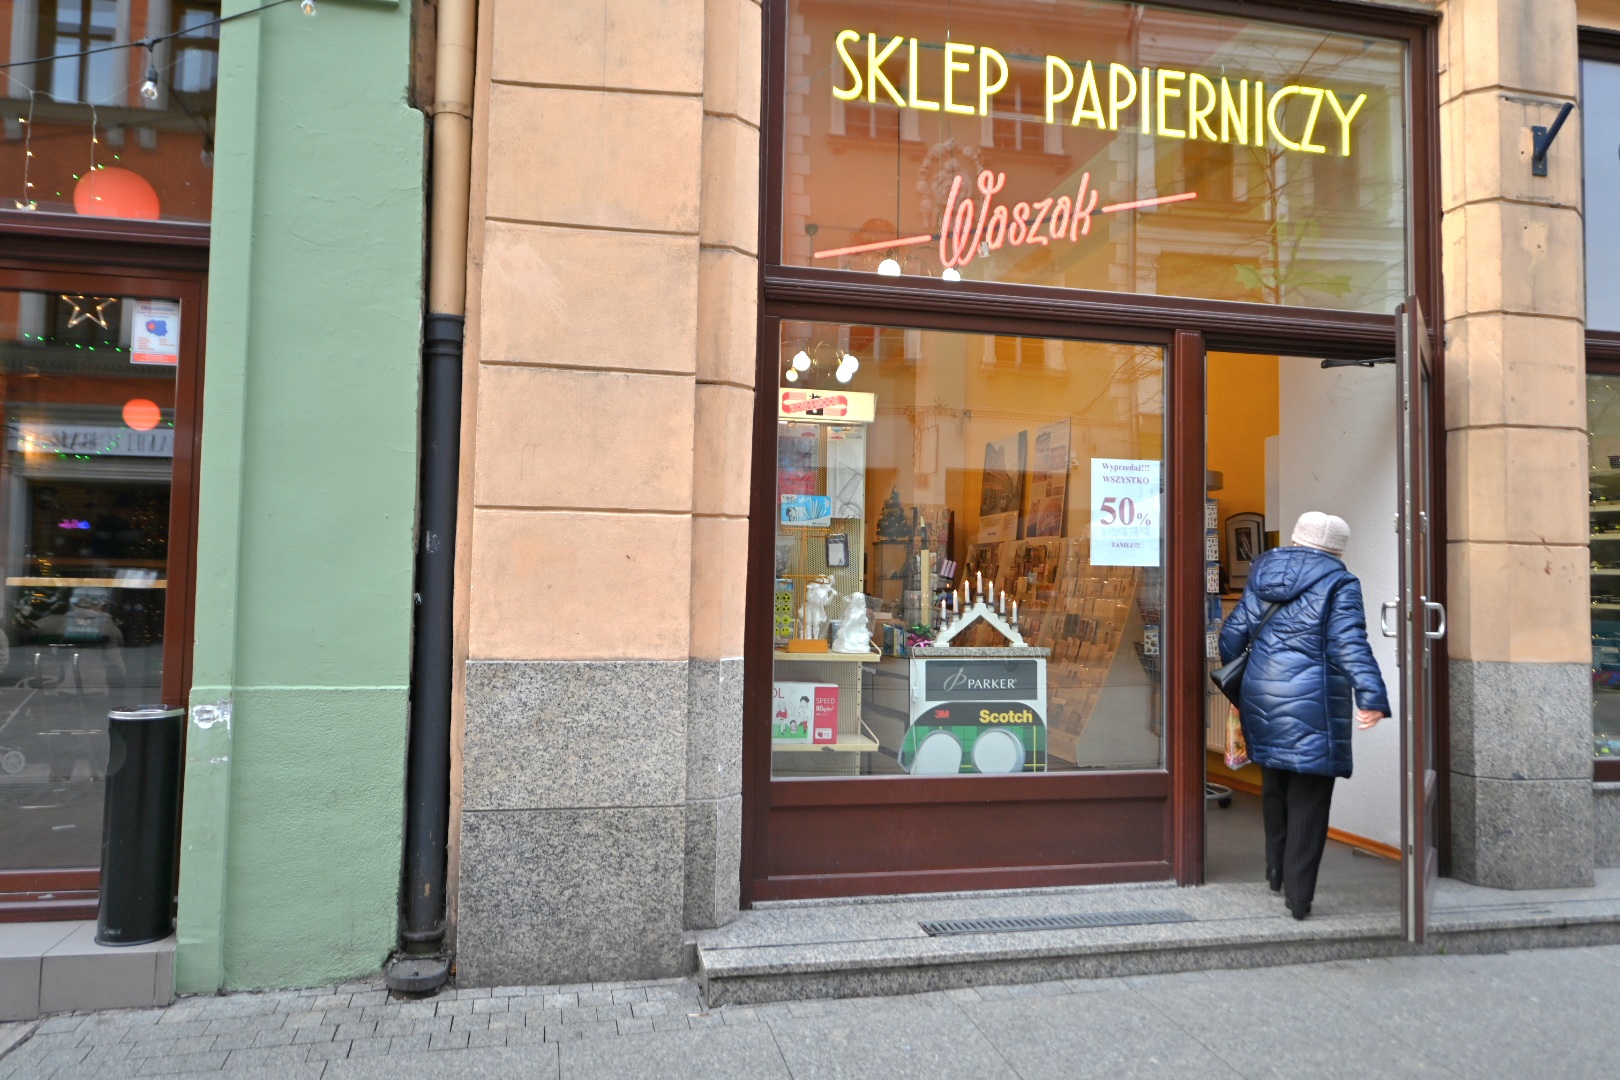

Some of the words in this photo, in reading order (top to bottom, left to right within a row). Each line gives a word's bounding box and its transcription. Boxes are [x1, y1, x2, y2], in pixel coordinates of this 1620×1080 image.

[832, 29, 1009, 116] SKLEP
[1045, 55, 1367, 156] PAPIERNICZY
[938, 169, 1099, 268] Waszak
[1102, 462, 1150, 472] Wyprzedaż!!!
[1102, 475, 1150, 484] WSZYSTKO
[1100, 497, 1151, 526] 50%
[968, 679, 1015, 689] PARKER
[934, 709, 950, 719] 3M
[979, 709, 1033, 723] Scotch
